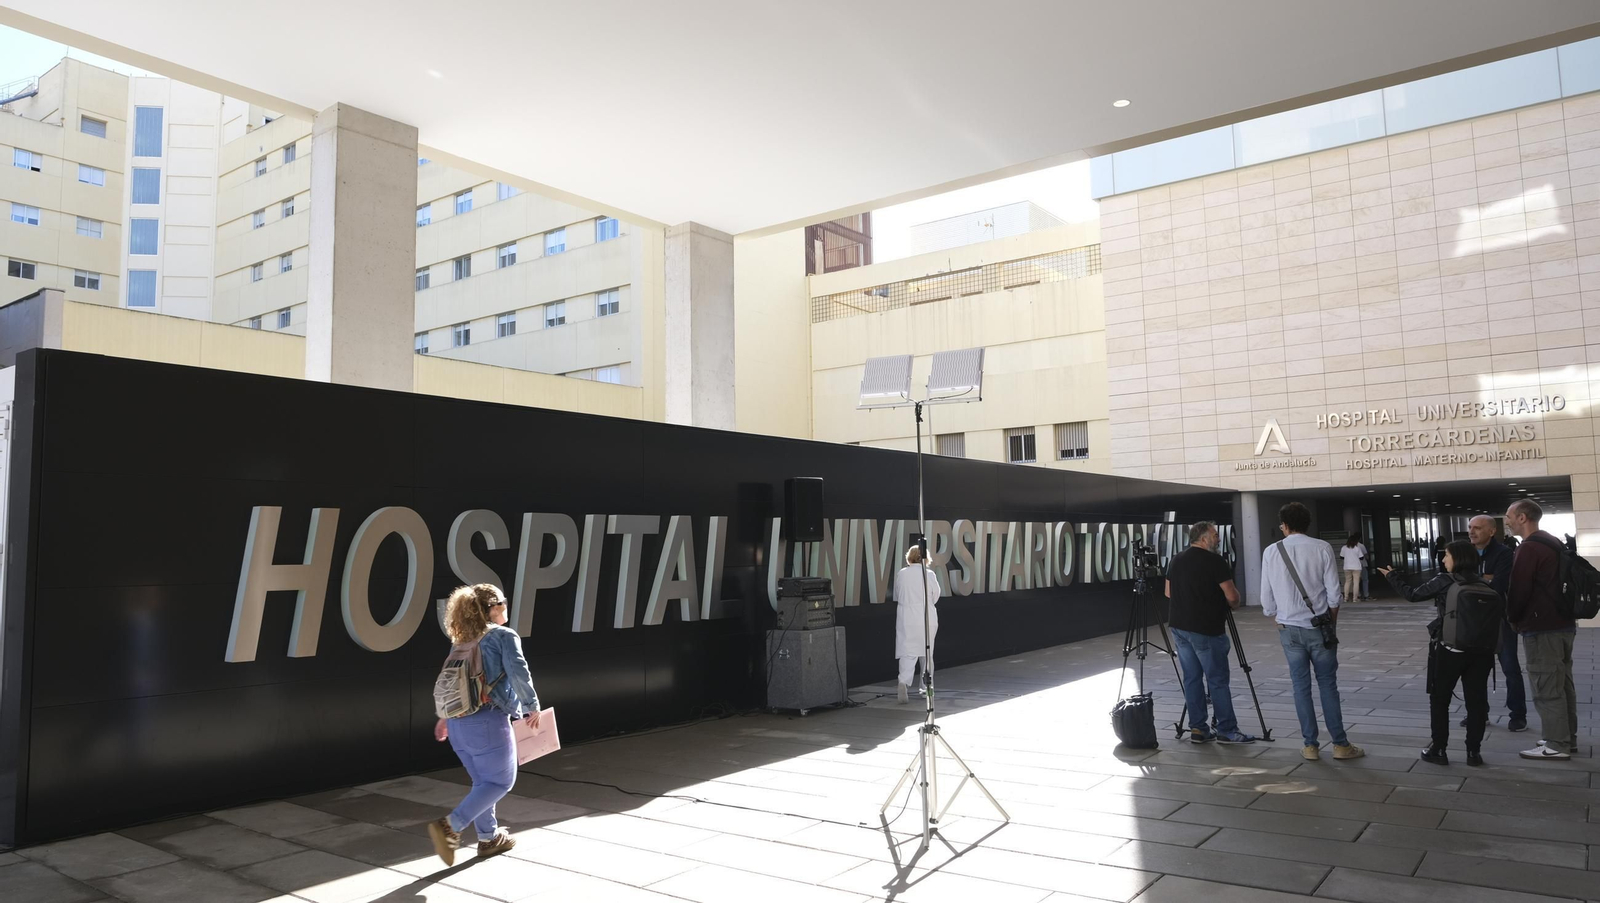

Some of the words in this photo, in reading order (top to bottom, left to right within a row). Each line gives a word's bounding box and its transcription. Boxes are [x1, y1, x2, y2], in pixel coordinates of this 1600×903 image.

[1317, 408, 1403, 429] HOSPITAL
[1417, 393, 1566, 421] UNIVERSITARIO
[1346, 424, 1537, 453] TORRECÁRDENAS
[1235, 461, 1258, 471] Junta
[1260, 461, 1271, 470] de
[1272, 457, 1317, 468] Andalucía
[1345, 457, 1406, 470] HOSPITAL
[1414, 448, 1545, 467] MATERNO-INFANTIL
[224, 506, 743, 663] HOSPITAL
